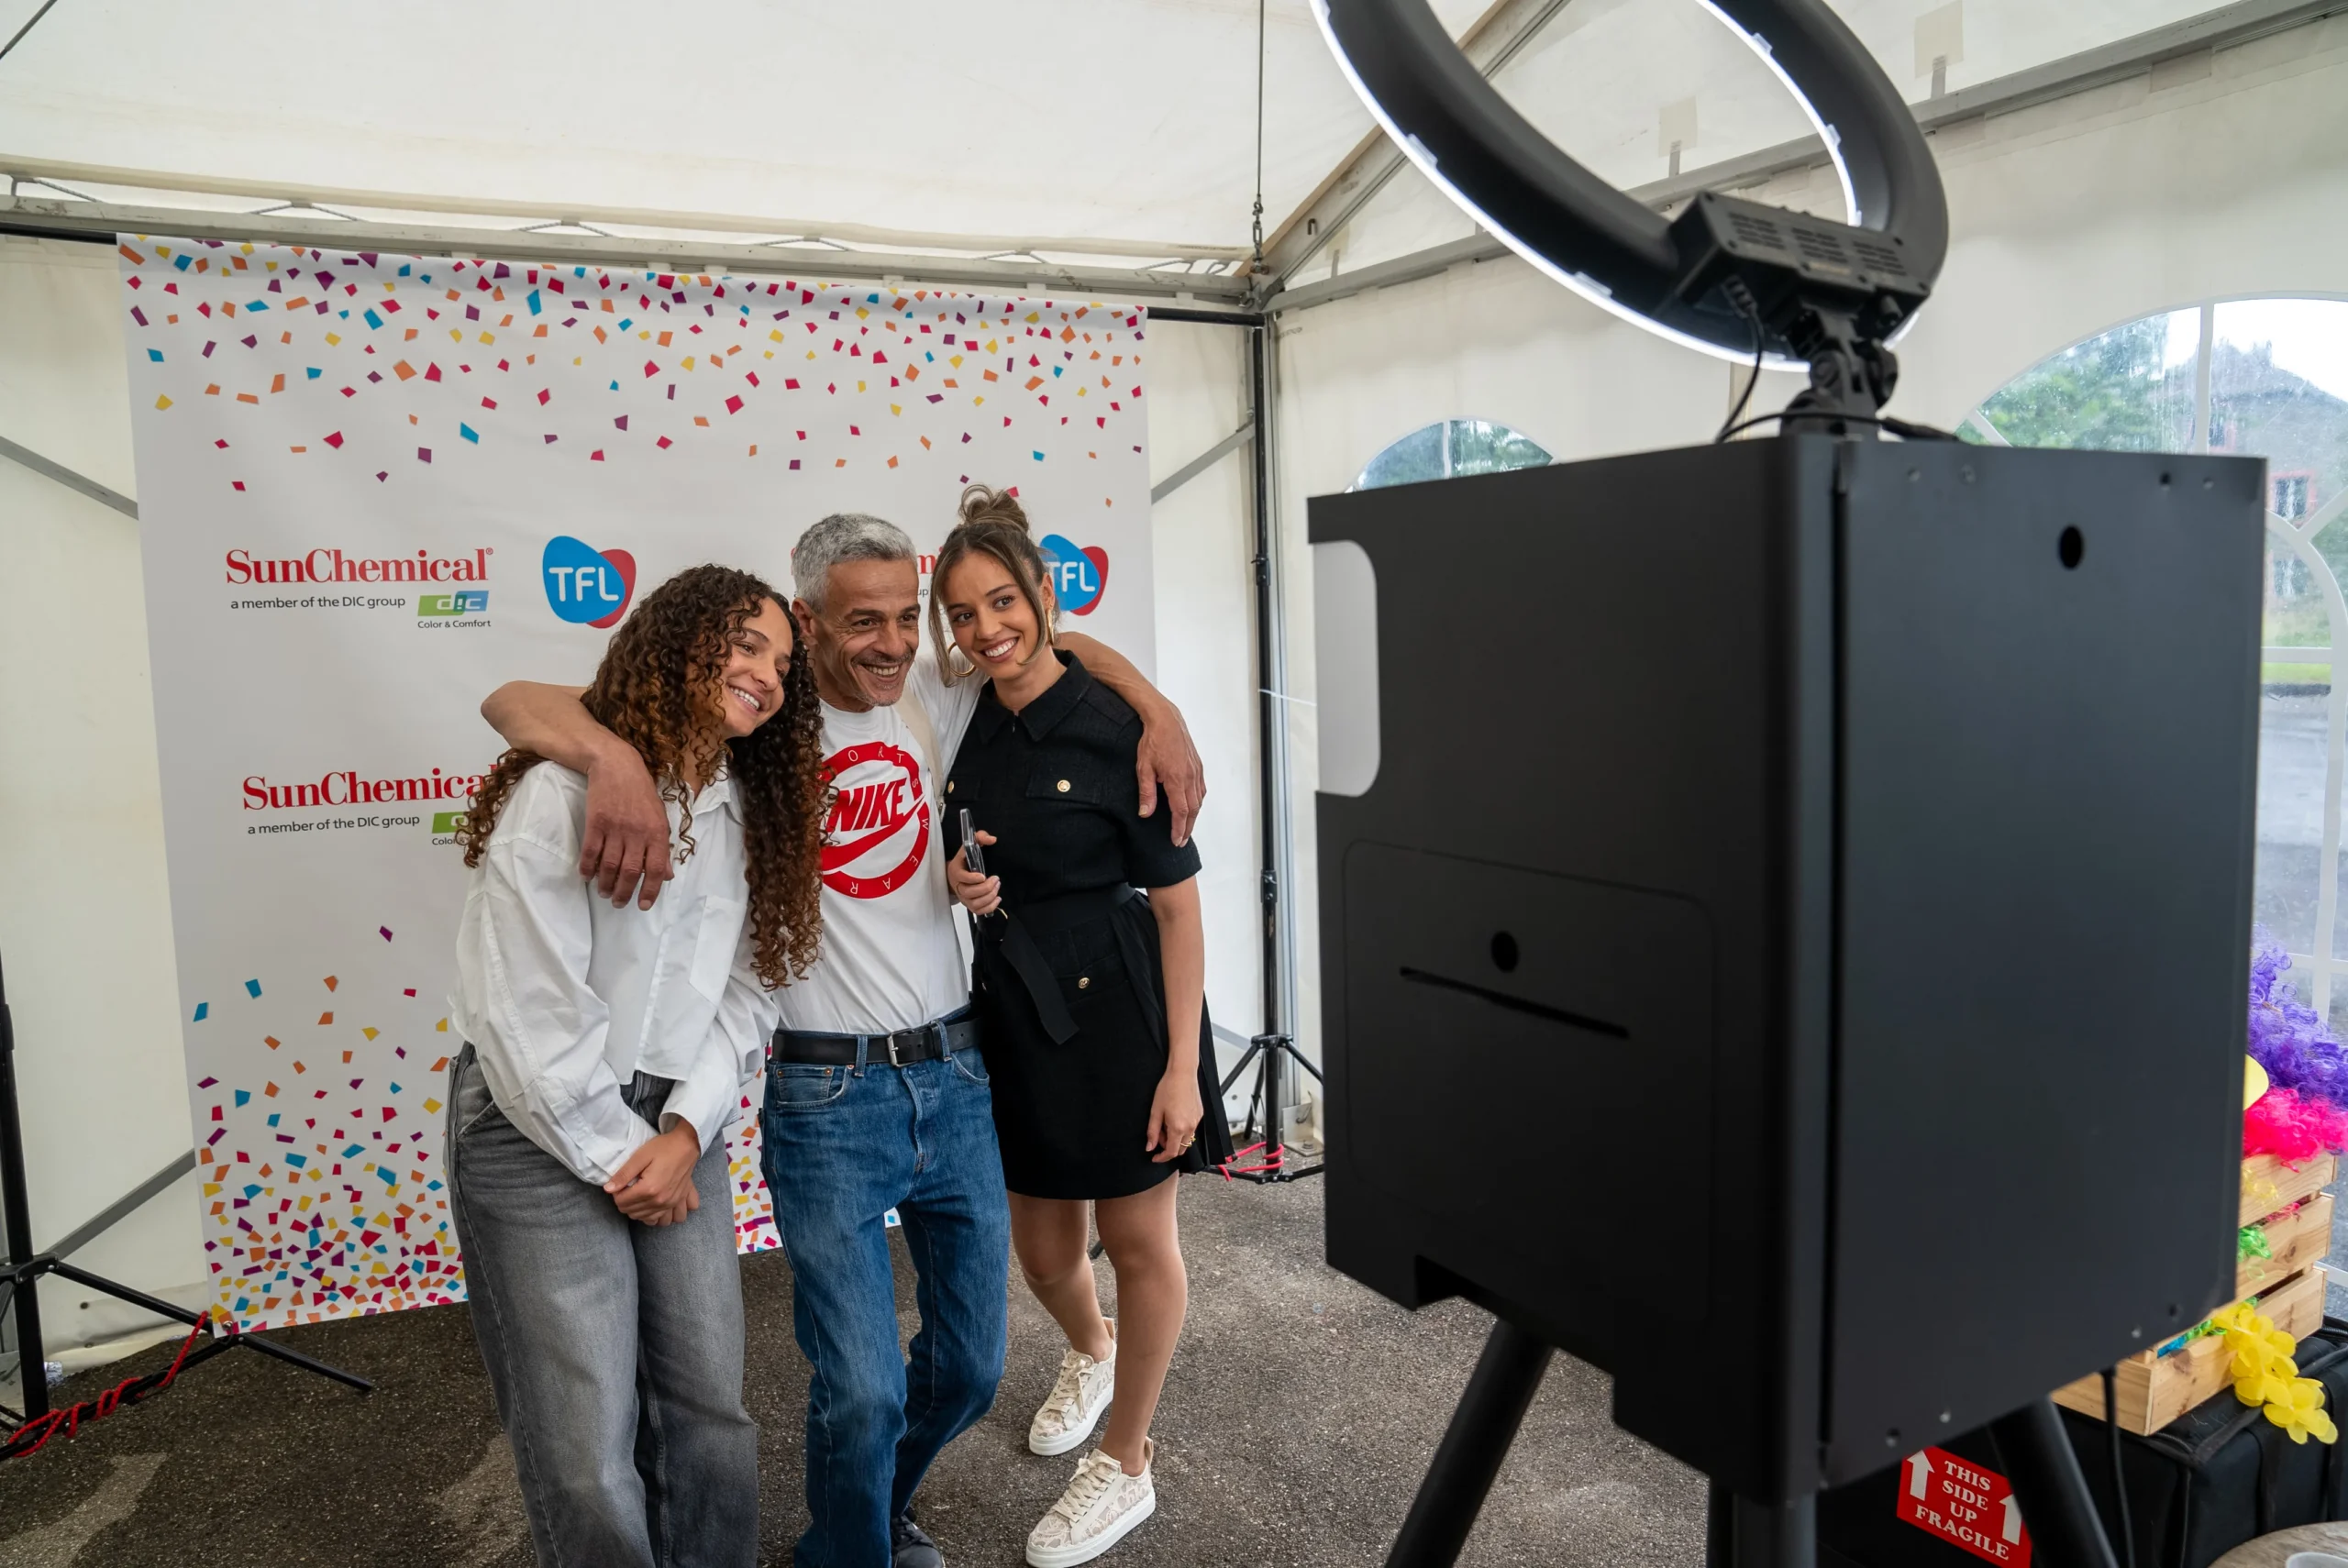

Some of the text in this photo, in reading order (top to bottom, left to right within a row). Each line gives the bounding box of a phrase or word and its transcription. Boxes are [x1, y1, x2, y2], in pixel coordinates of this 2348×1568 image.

[548, 566, 620, 602] TFL
[1044, 561, 1096, 592] TFL
[230, 596, 405, 610] a member of the DIC group
[417, 620, 443, 629] Color
[452, 619, 492, 629] Comfort
[243, 763, 498, 811] SunChemica
[825, 777, 908, 833] NIKE
[248, 815, 420, 834] a member of the DIC group
[1944, 1460, 1991, 1492] THIS
[1942, 1480, 1988, 1511] SIDE
[1950, 1501, 1977, 1523] UP
[1914, 1504, 2010, 1562] FRAGILE
